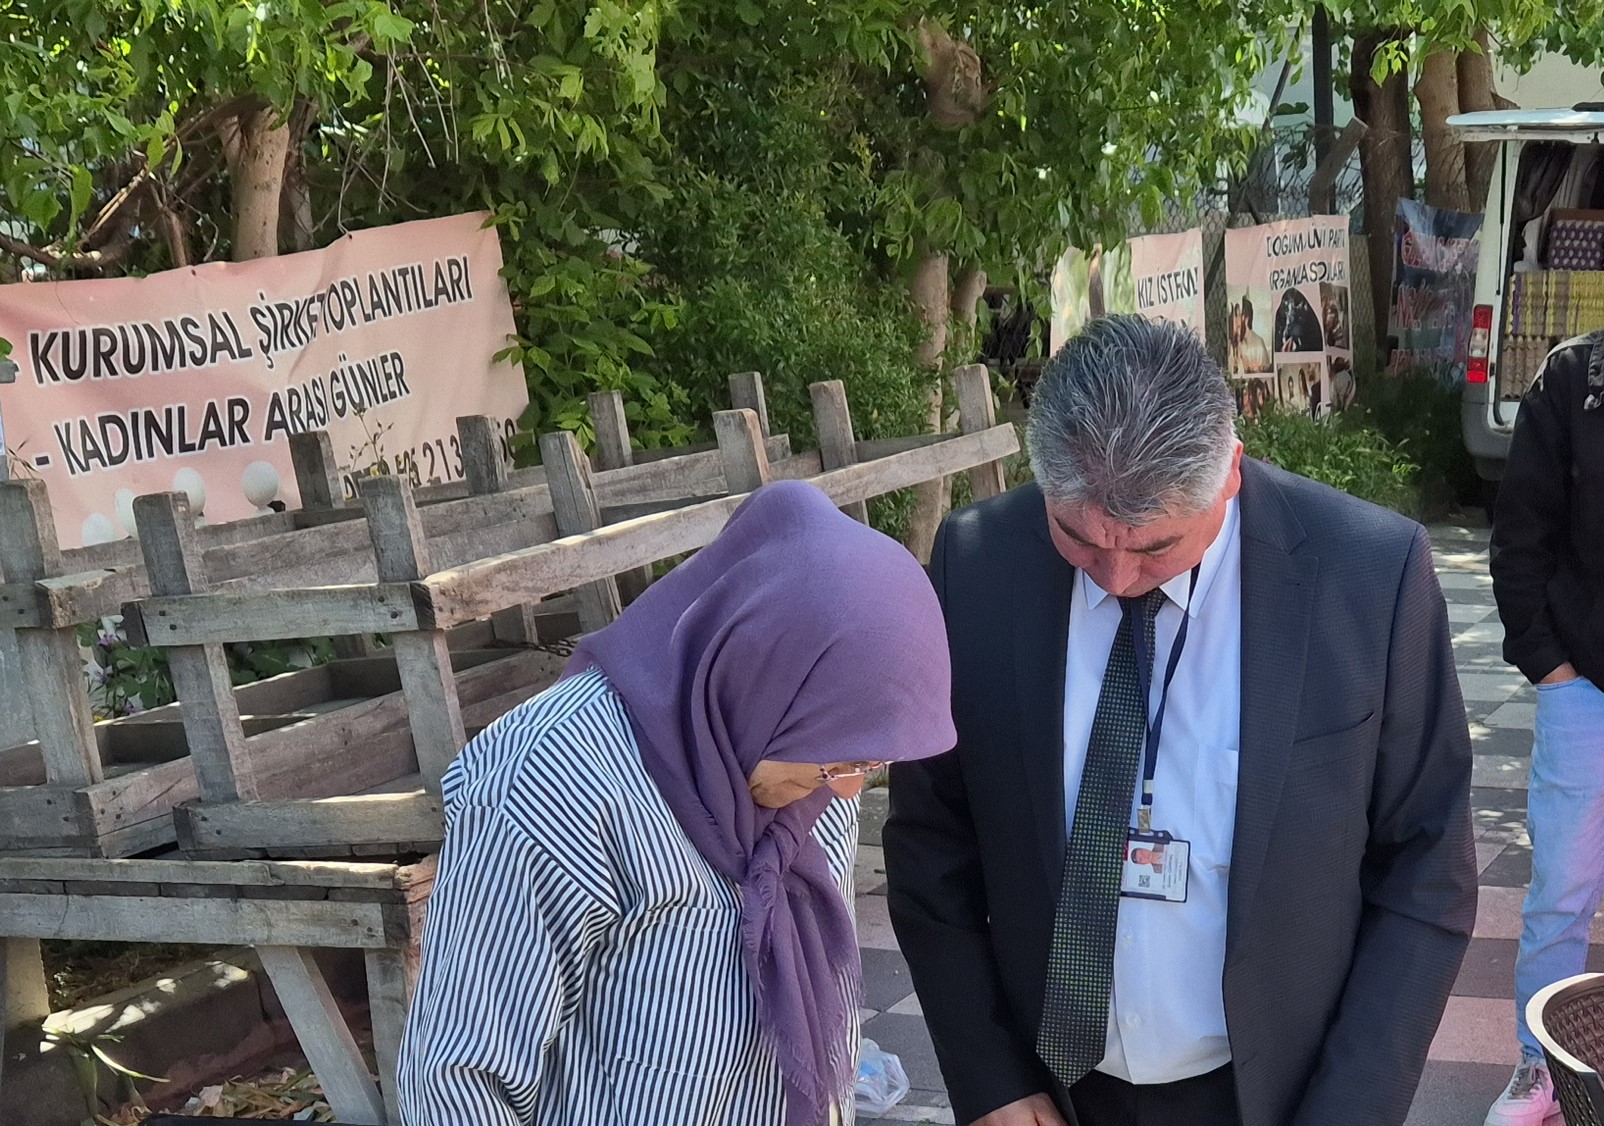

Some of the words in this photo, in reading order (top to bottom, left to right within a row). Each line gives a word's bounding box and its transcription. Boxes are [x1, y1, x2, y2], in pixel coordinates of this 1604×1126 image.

[1137, 276, 1155, 309] KIZ
[29, 311, 253, 384] KURUMSAL
[54, 398, 251, 475] KADINLAR
[264, 376, 331, 442] ARASI
[329, 352, 411, 419] GÜNLER
